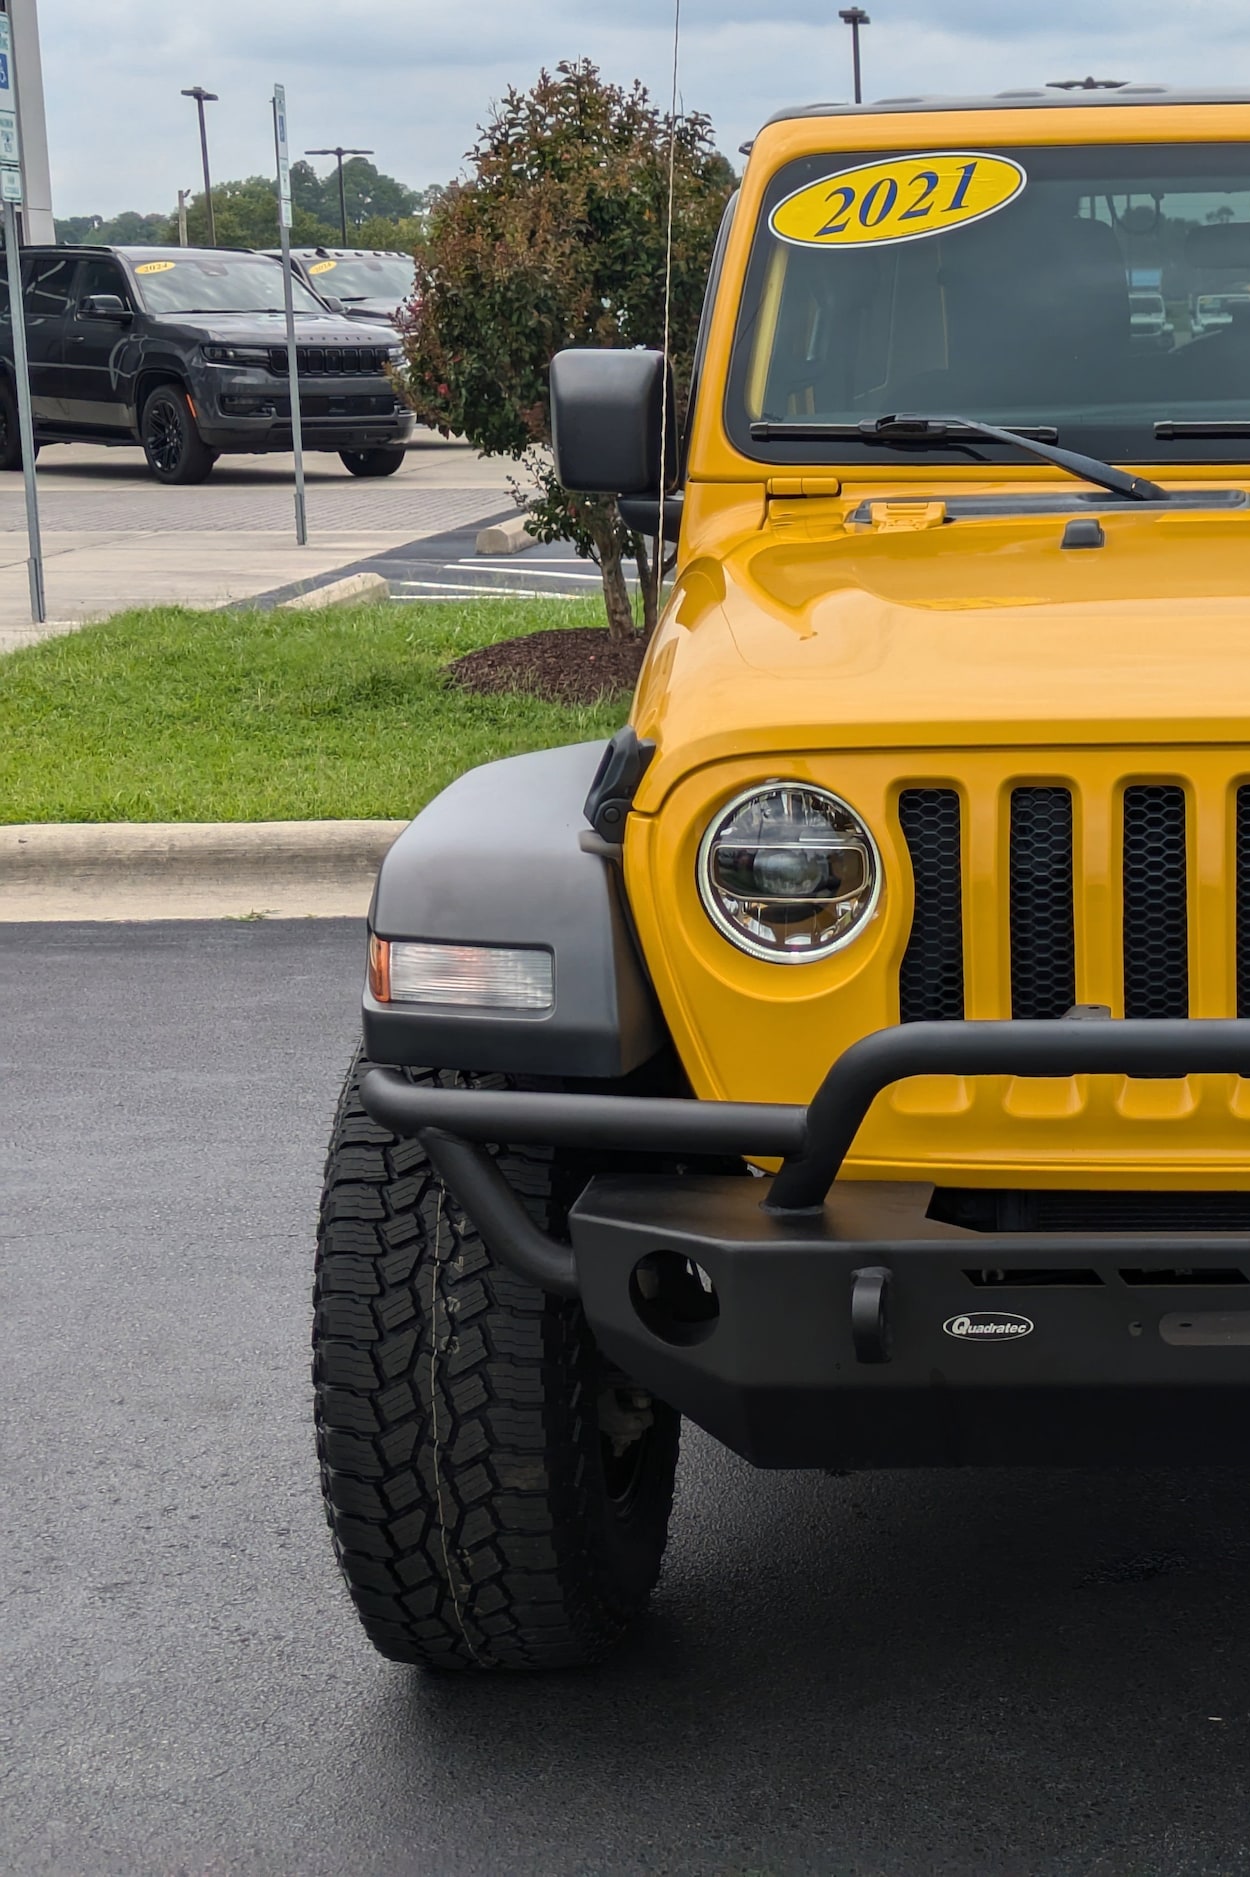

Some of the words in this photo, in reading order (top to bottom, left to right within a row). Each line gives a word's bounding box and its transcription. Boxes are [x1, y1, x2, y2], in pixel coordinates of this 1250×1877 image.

[814, 161, 977, 237] 2021
[144, 263, 168, 273] 2024
[952, 1316, 1027, 1335] Quadratec
